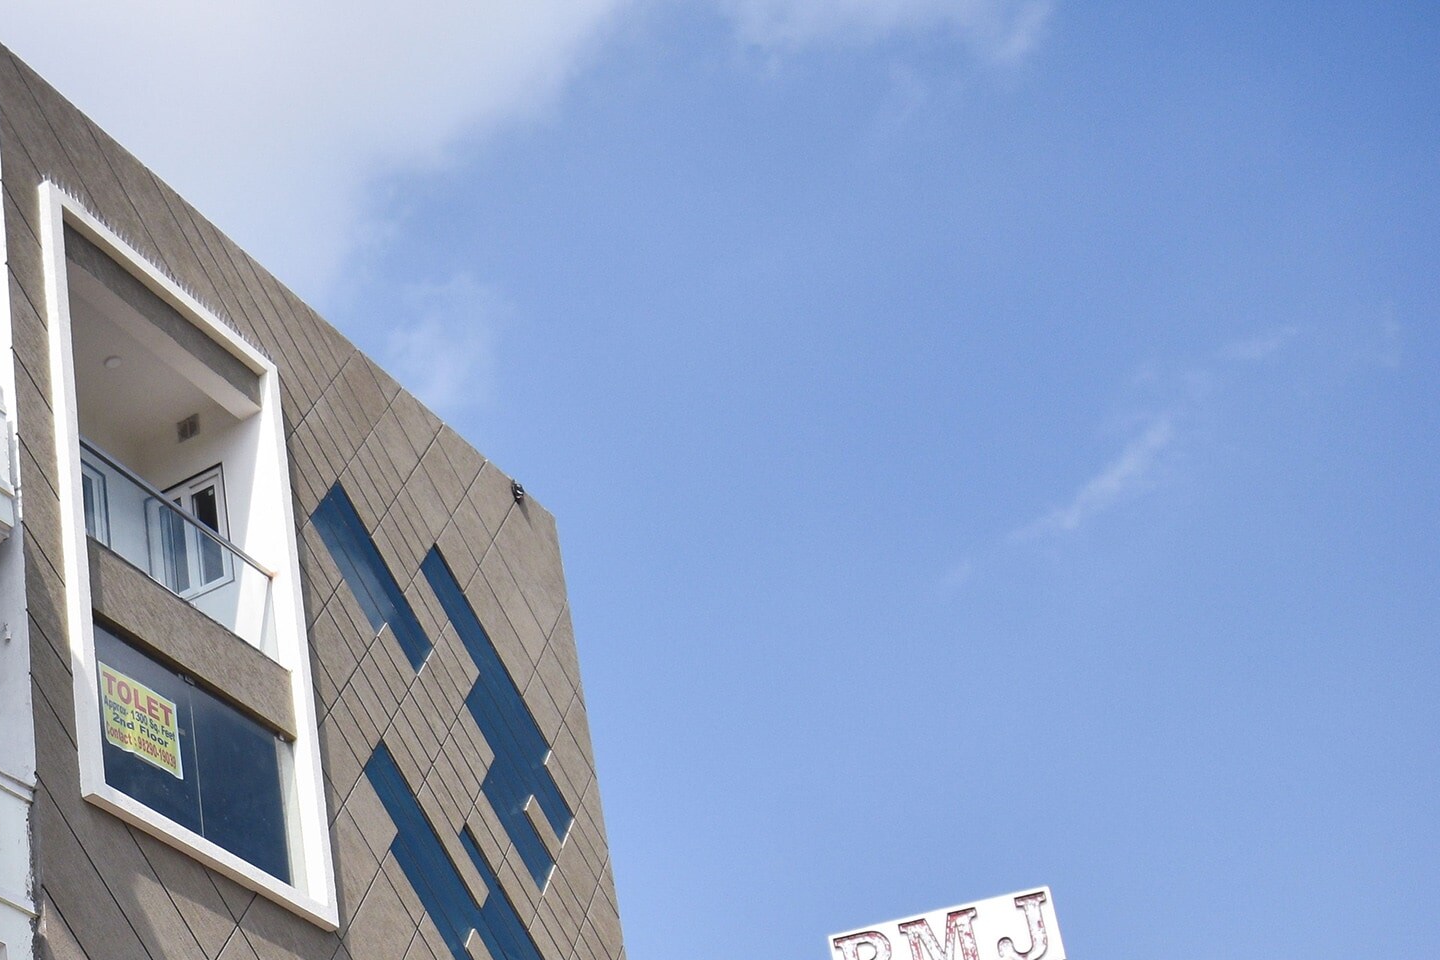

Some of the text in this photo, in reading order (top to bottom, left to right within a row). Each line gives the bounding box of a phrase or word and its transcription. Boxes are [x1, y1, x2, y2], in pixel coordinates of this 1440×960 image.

[102, 670, 172, 727] TOLET
[113, 712, 169, 748] 2nd Floor
[162, 726, 176, 742] Feet
